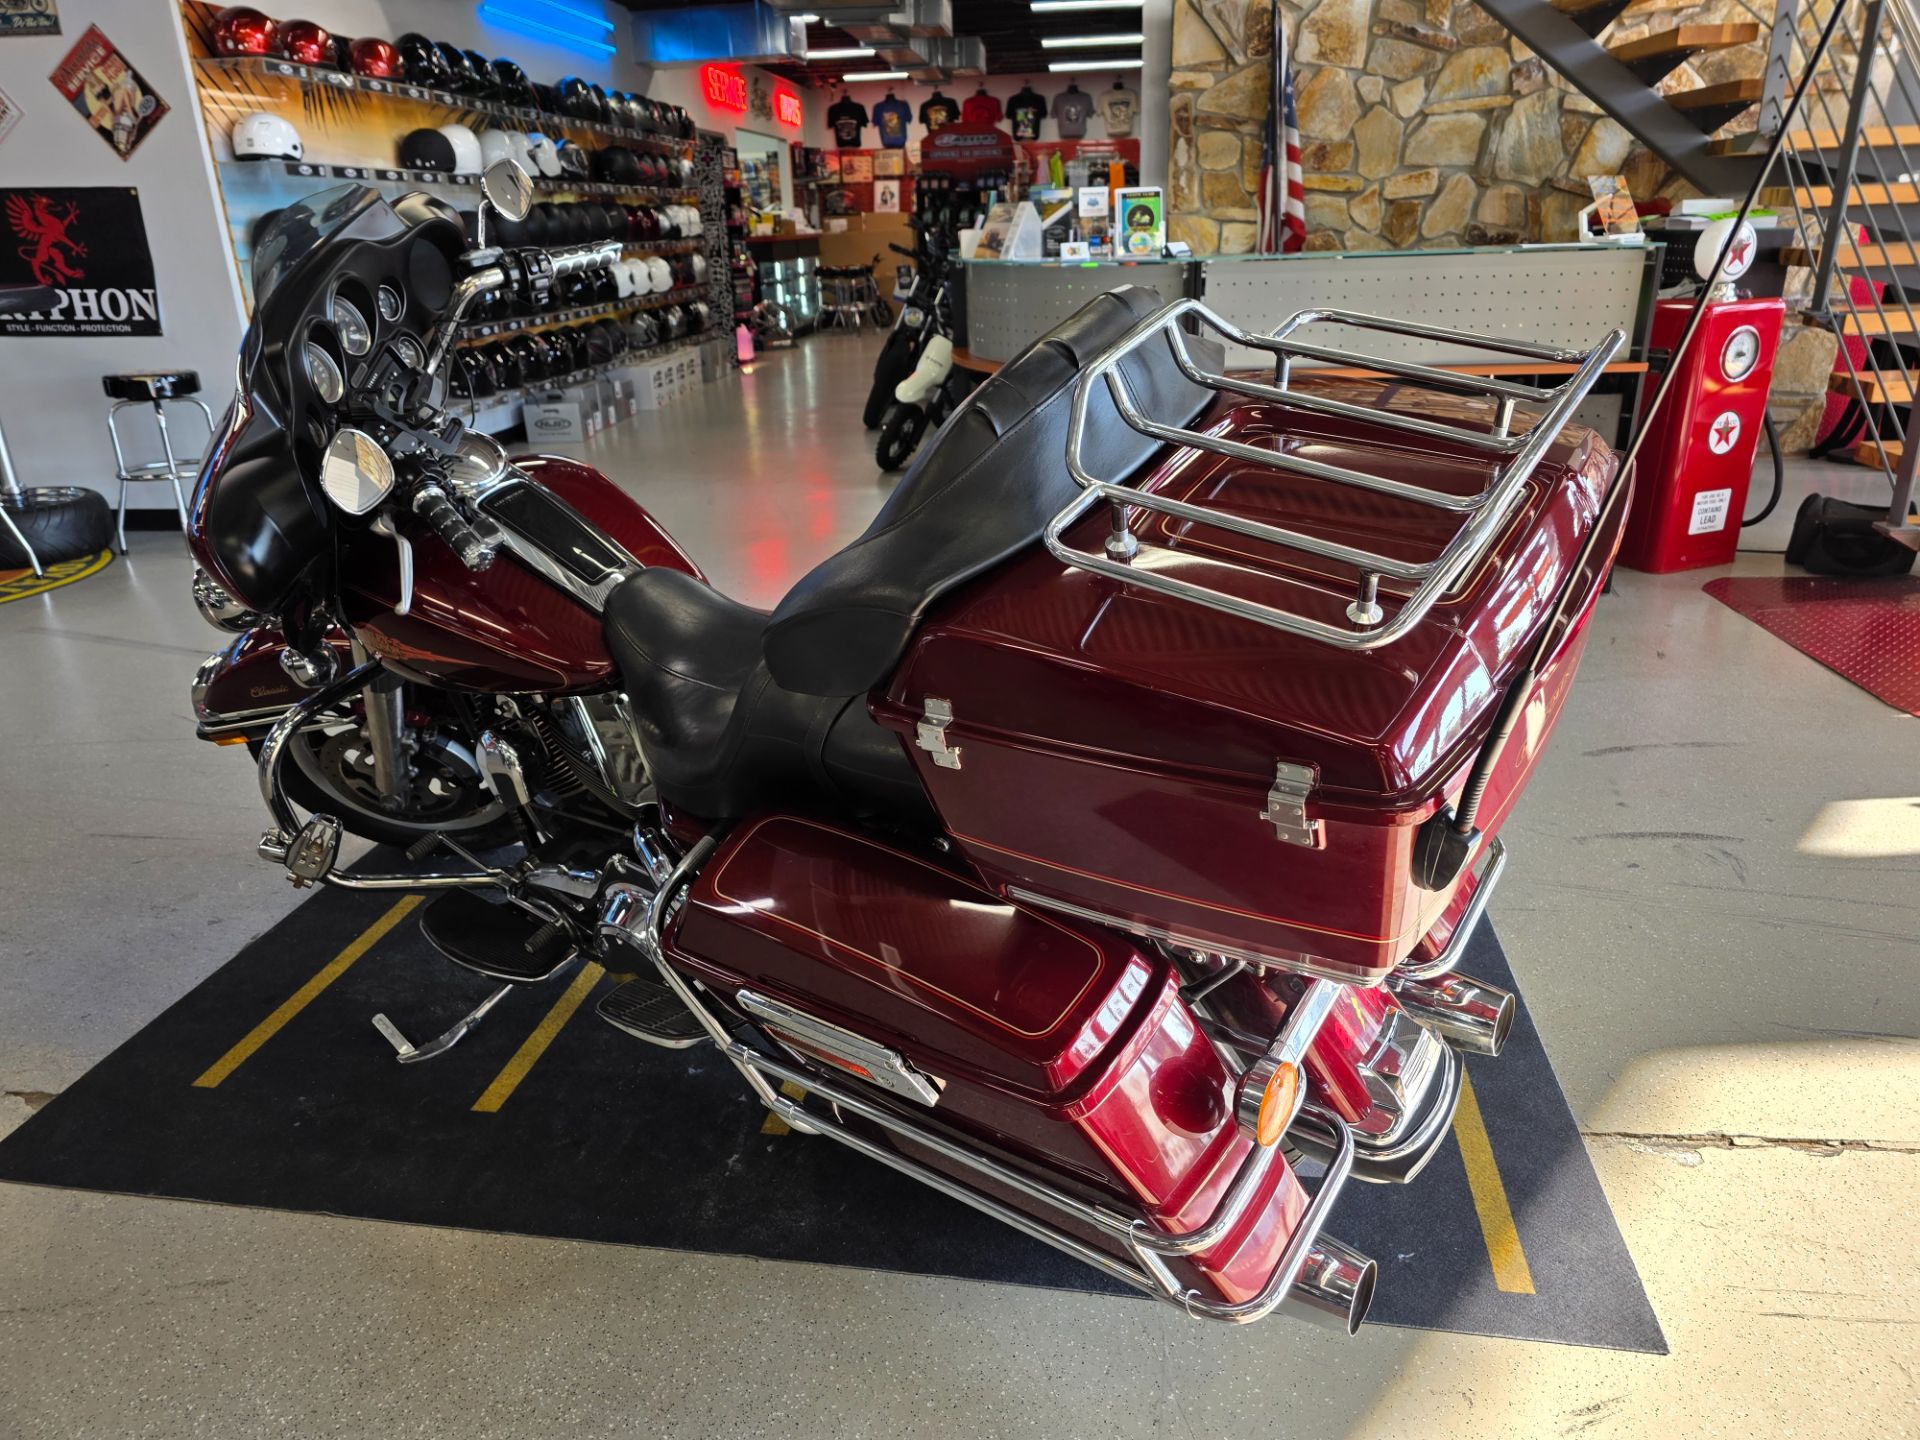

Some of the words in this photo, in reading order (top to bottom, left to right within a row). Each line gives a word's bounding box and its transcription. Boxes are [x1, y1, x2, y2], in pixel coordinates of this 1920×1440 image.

[66, 45, 107, 93] SERVICE
[0, 288, 157, 321] PHON
[6, 324, 31, 332] STYLE
[36, 324, 76, 332] FUNCTION
[80, 324, 132, 332] PROTECTION
[1698, 506, 1722, 515] CONTAINS
[1700, 514, 1717, 525] LEAD
[250, 686, 289, 698] Classic
